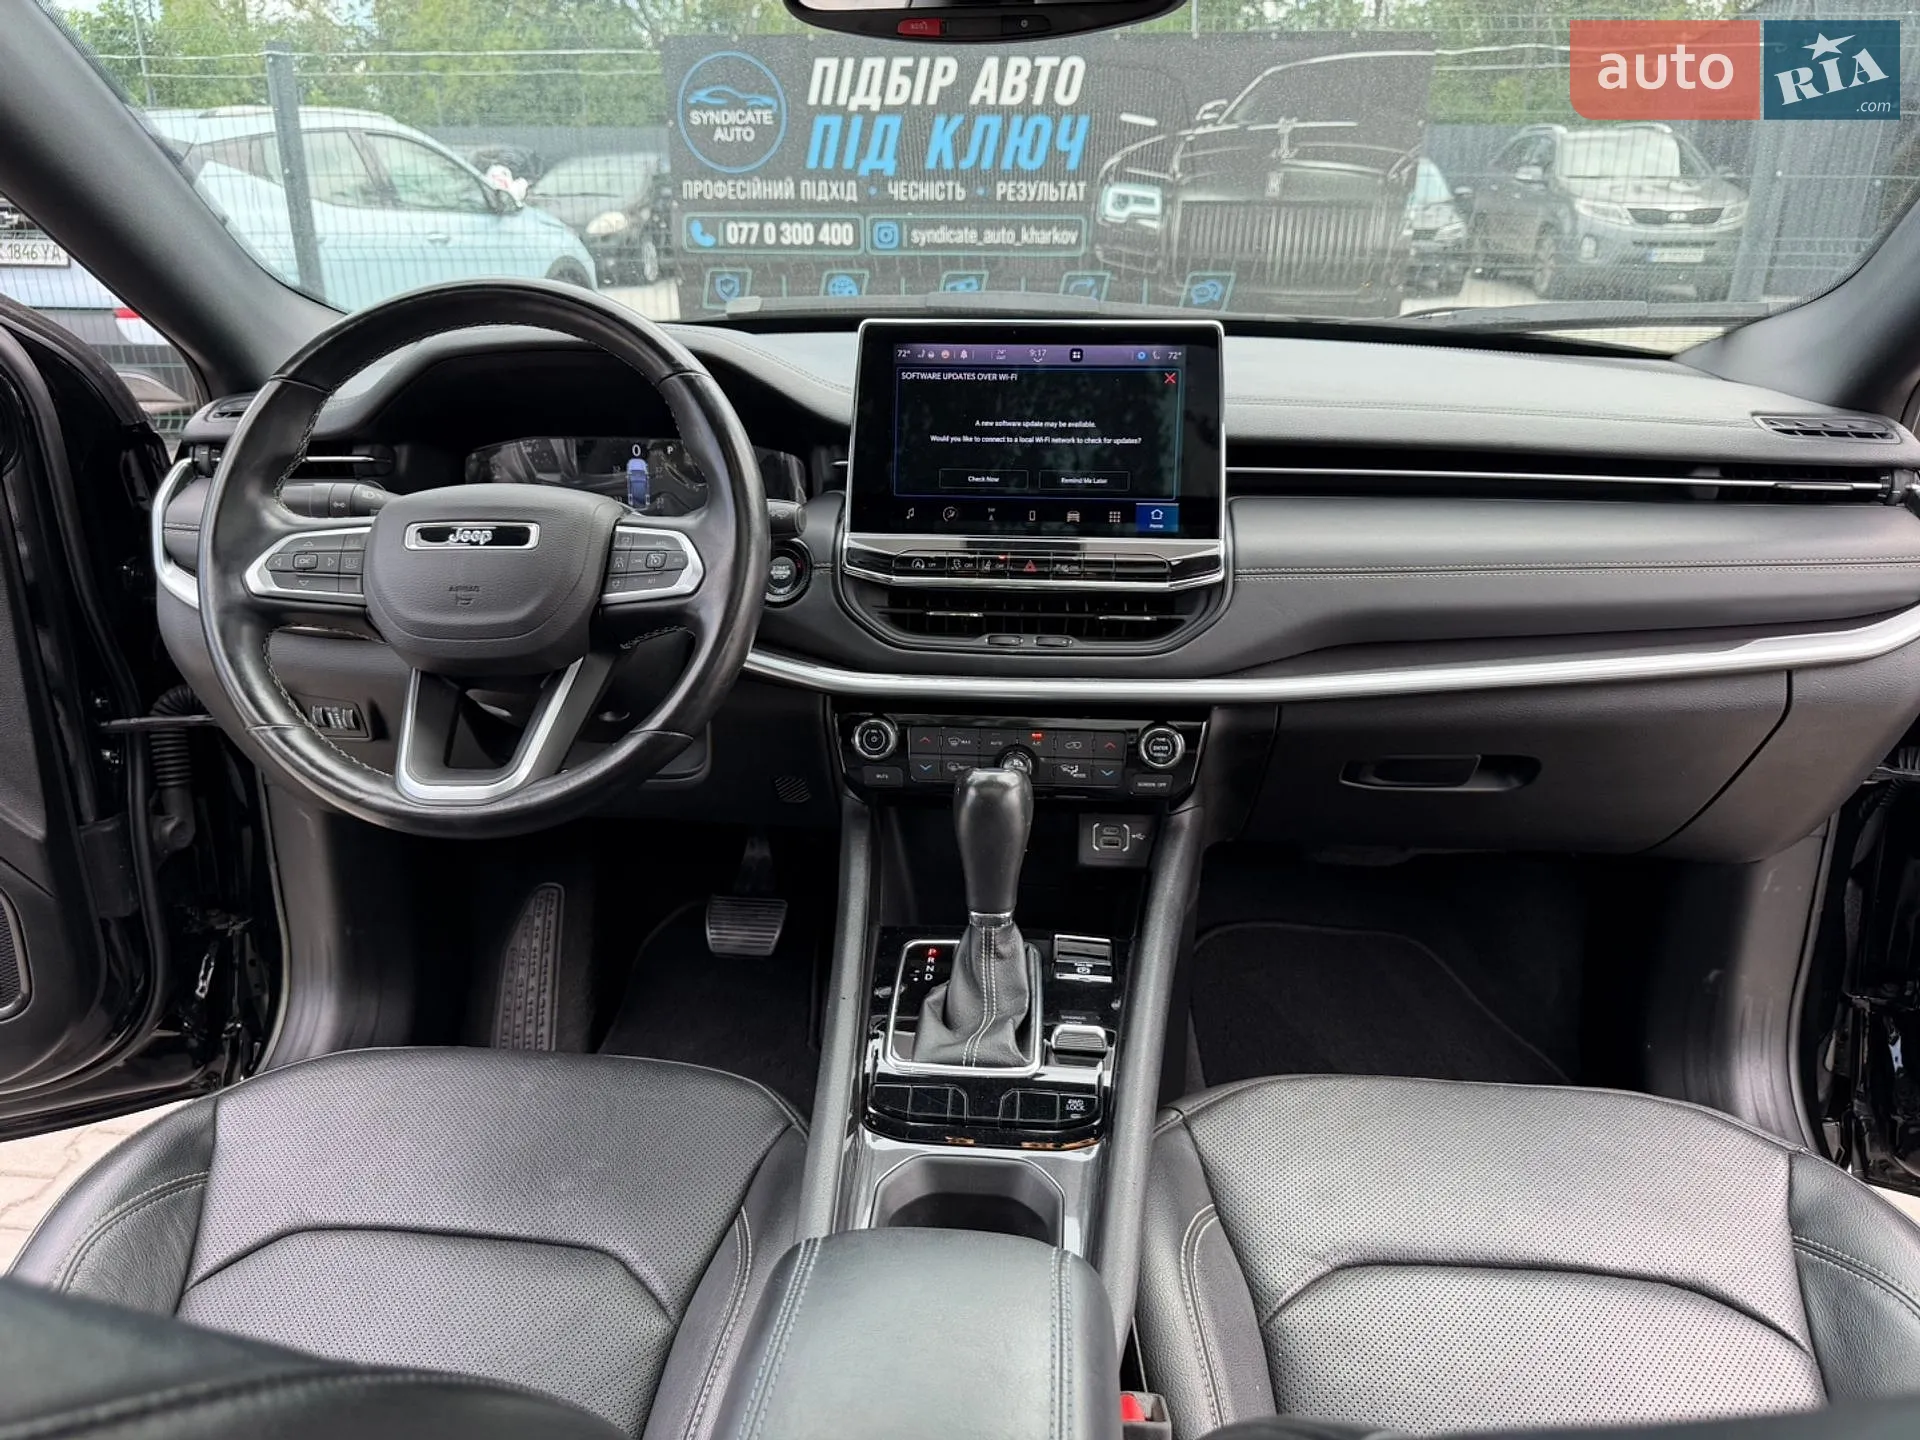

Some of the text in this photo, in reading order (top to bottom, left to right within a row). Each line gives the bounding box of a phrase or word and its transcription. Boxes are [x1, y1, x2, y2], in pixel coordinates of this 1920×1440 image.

[807, 57, 1086, 112] ПІДБІР АВТО
[689, 109, 774, 125] SYNDICATE
[713, 127, 756, 142] AUTO
[806, 114, 1090, 177] ПІД КЛЮЧ
[682, 176, 1087, 202] ПРОФЕСІЙНИЙ ПІДХІД ЧЕСНІСТЬ РЕЗУЛЬТАТ
[726, 222, 854, 245] 077 0 300 400
[910, 226, 1079, 247] syndicate_auto_kharkov
[7, 243, 38, 260] 1846
[901, 371, 1018, 382] SOFTWARE UPDATES OVER WI-FI
[930, 434, 950, 442] Would
[449, 528, 492, 545] Jeep
[924, 973, 934, 981] D
